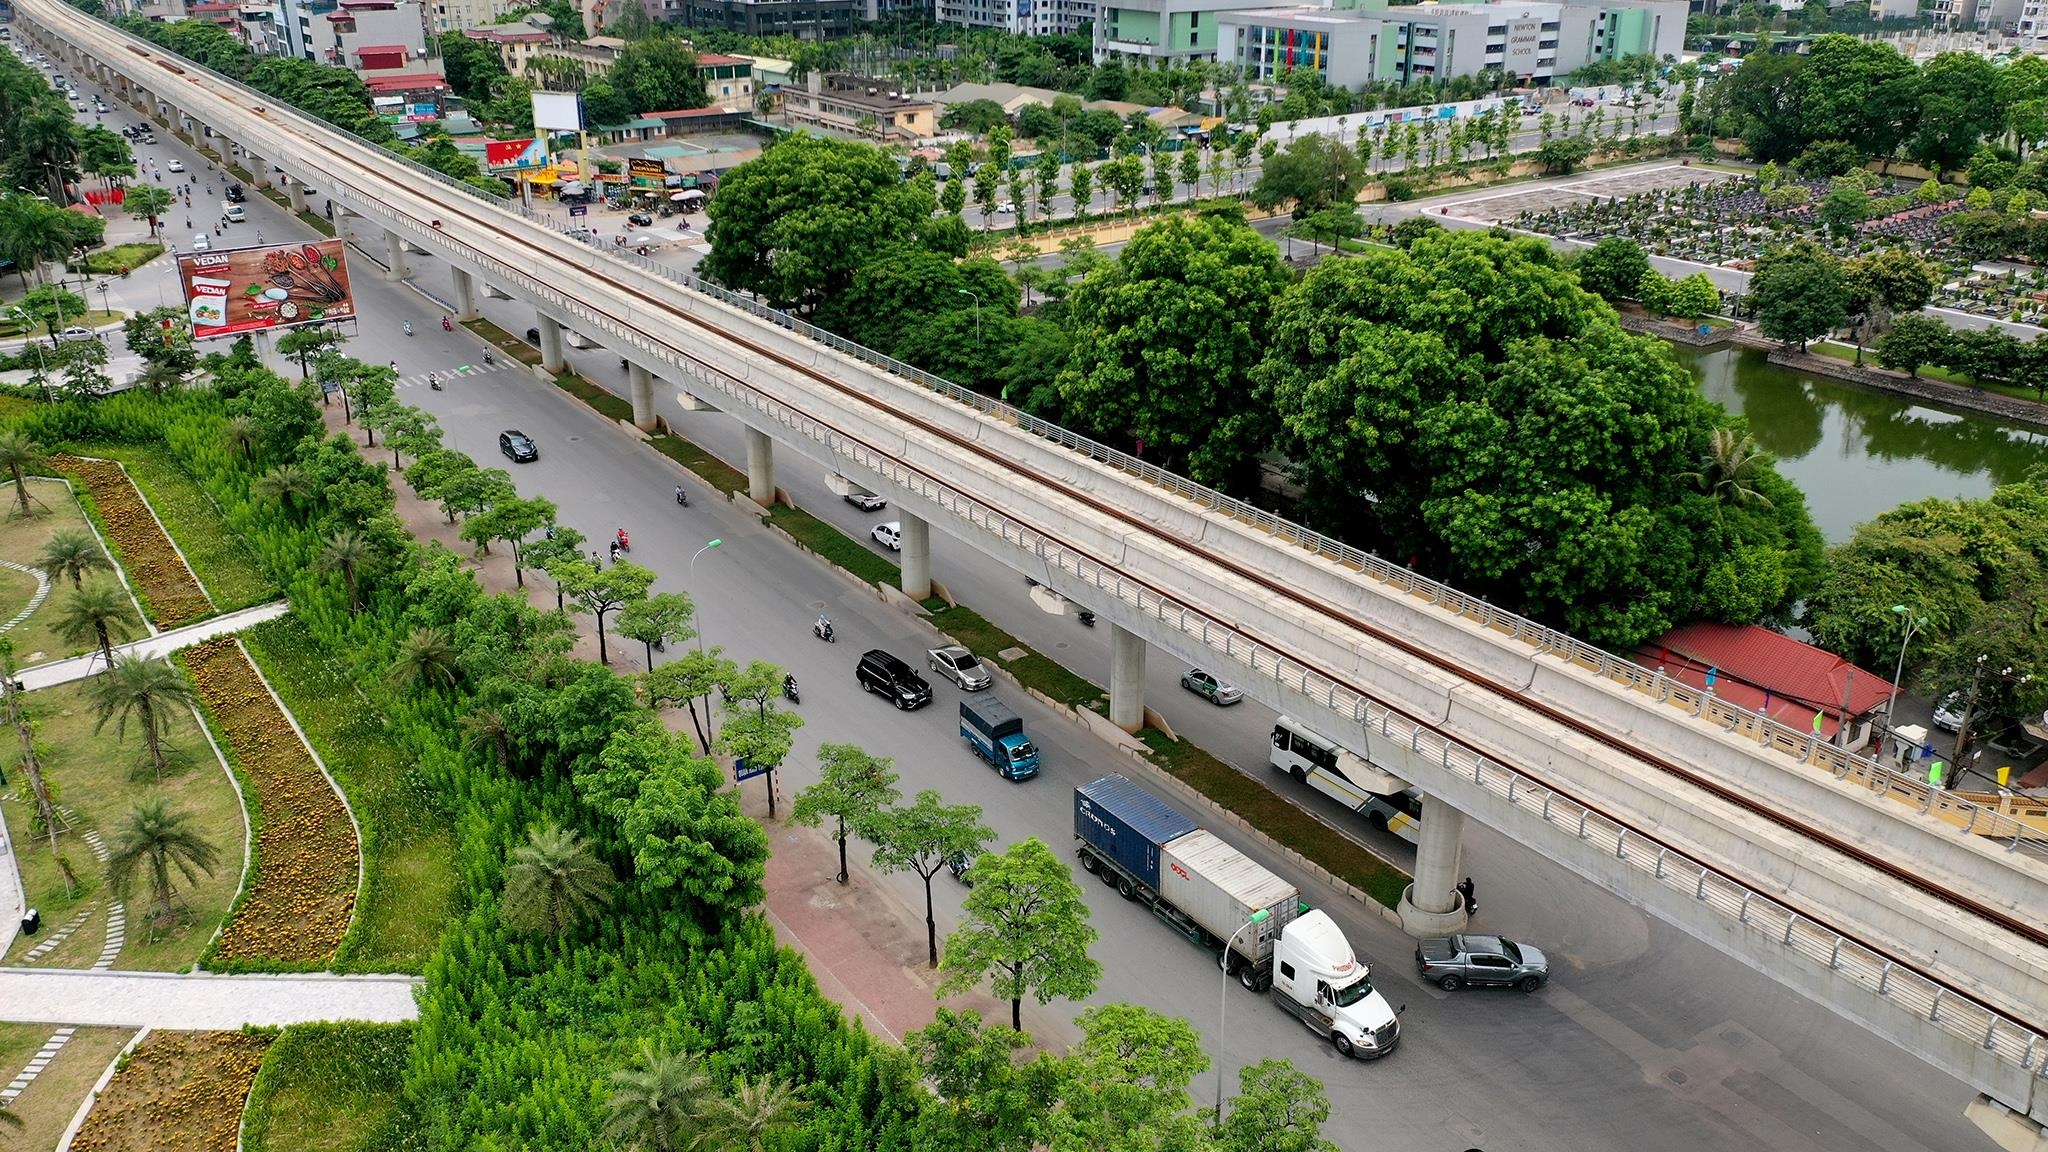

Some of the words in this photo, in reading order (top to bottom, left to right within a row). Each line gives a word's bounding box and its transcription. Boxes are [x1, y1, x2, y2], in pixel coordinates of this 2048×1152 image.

[1513, 23, 1536, 31] NEWTON
[1511, 35, 1536, 44] GRAMMAR
[1512, 47, 1531, 56] SCHOOL
[193, 254, 229, 266] VEDAN
[195, 285, 226, 296] VEDAN
